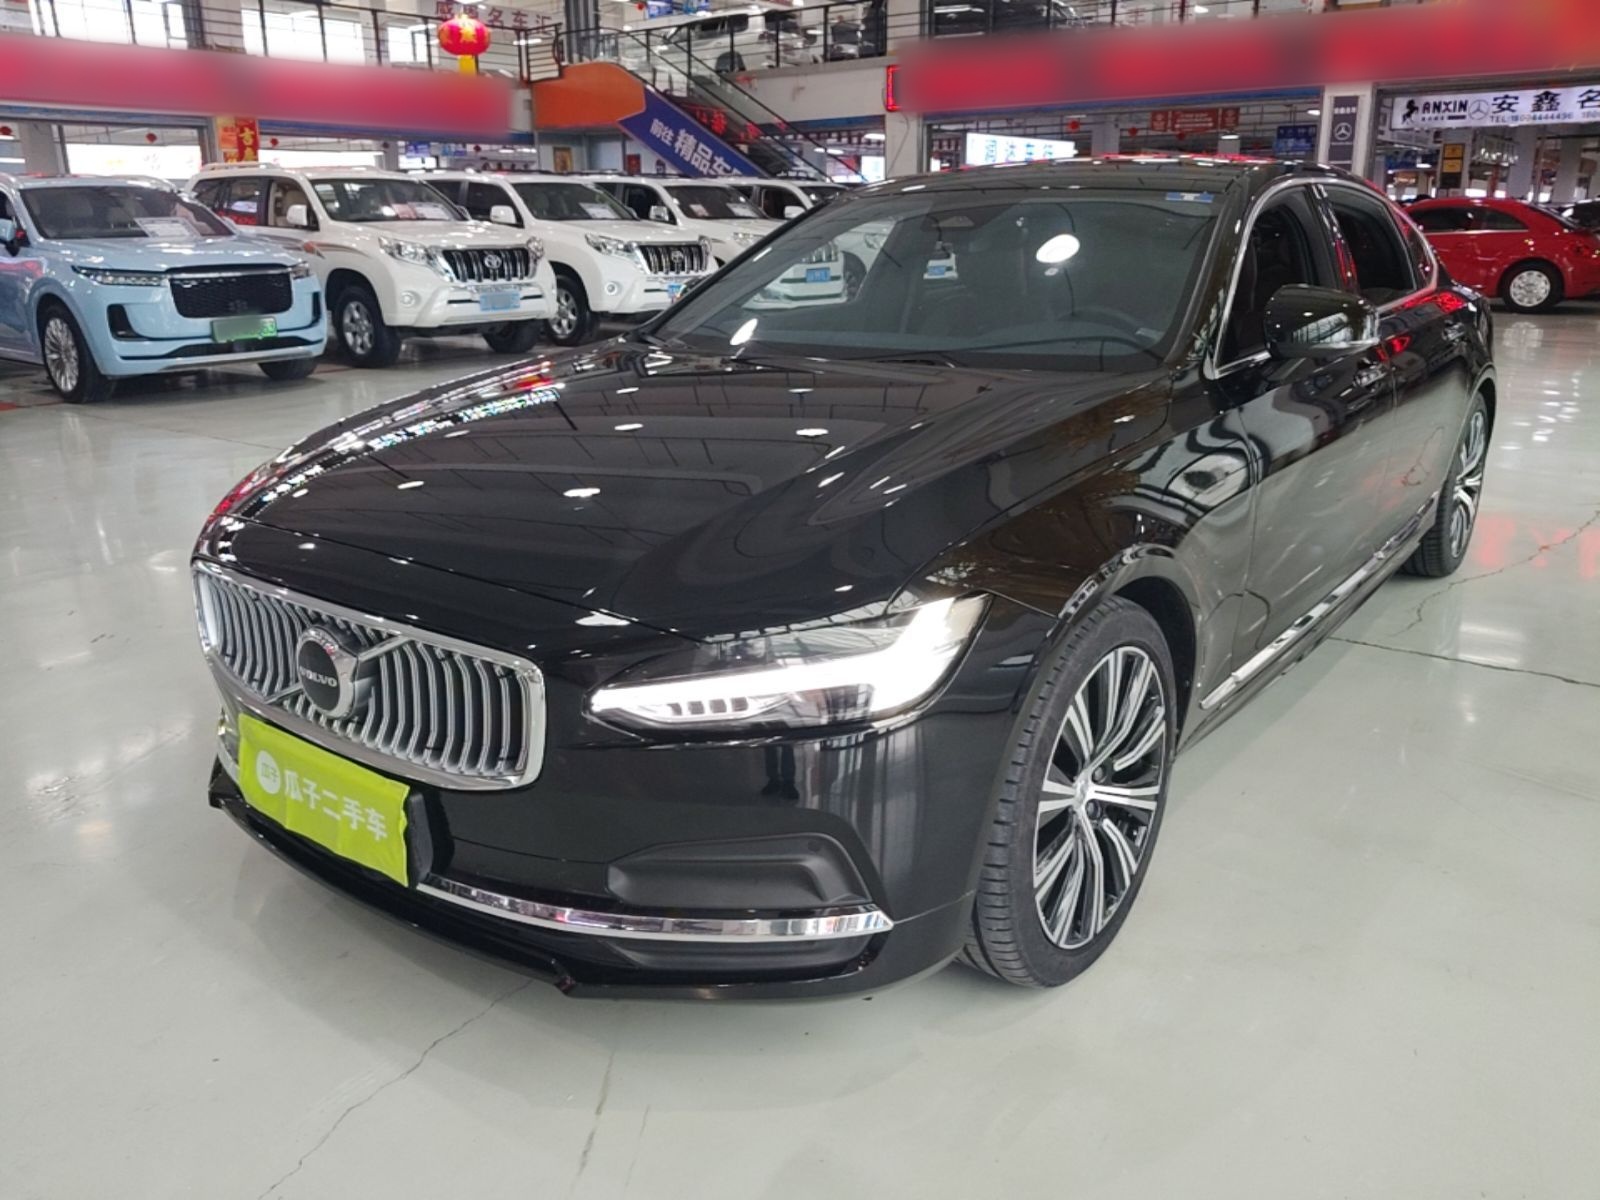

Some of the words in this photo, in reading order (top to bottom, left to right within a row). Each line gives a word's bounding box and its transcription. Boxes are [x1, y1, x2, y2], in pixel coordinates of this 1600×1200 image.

[1422, 100, 1469, 115] ANXIN
[299, 665, 338, 688] VOLVO
[284, 770, 388, 842] 瓜子二手车
